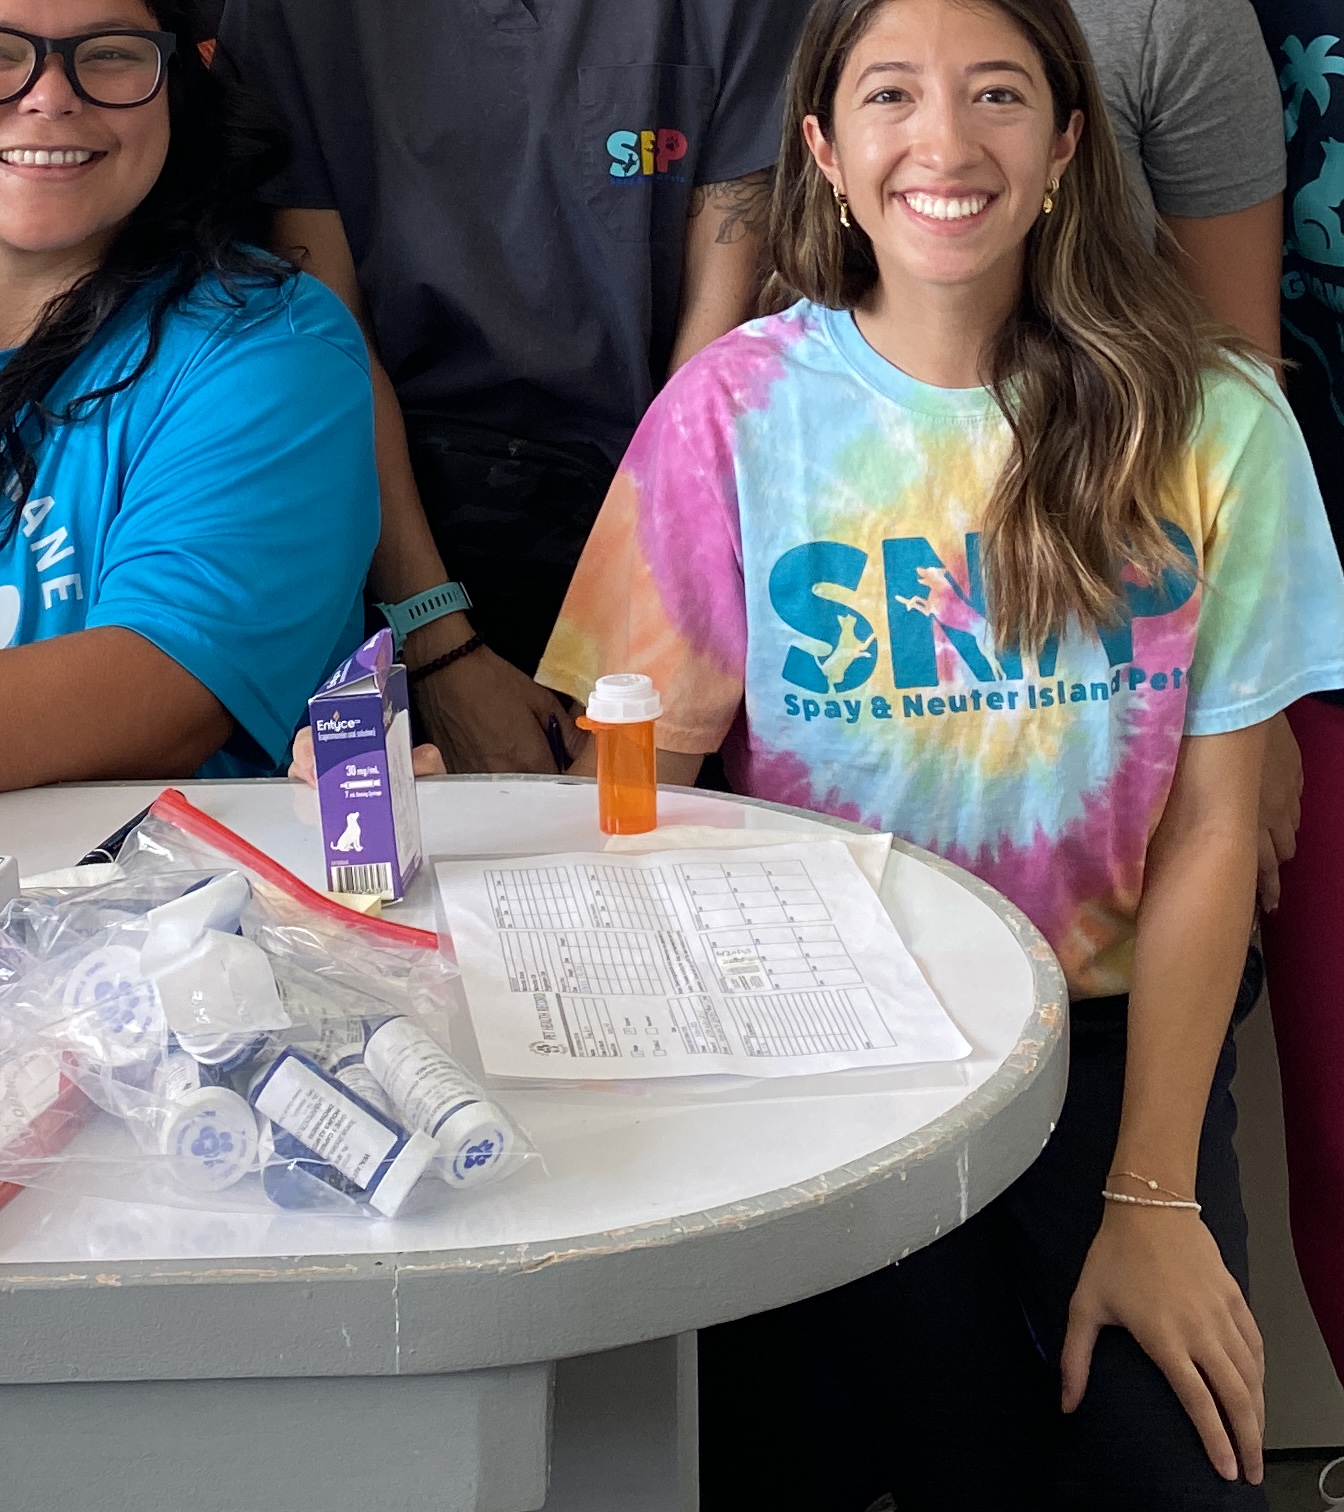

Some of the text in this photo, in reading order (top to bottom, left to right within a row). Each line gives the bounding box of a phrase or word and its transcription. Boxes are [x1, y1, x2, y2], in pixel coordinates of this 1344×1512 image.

[785, 693, 861, 724] Spay
[871, 697, 893, 720] &
[902, 691, 1020, 719] Neuter
[1028, 670, 1120, 711] Island
[345, 765, 356, 776] 30
